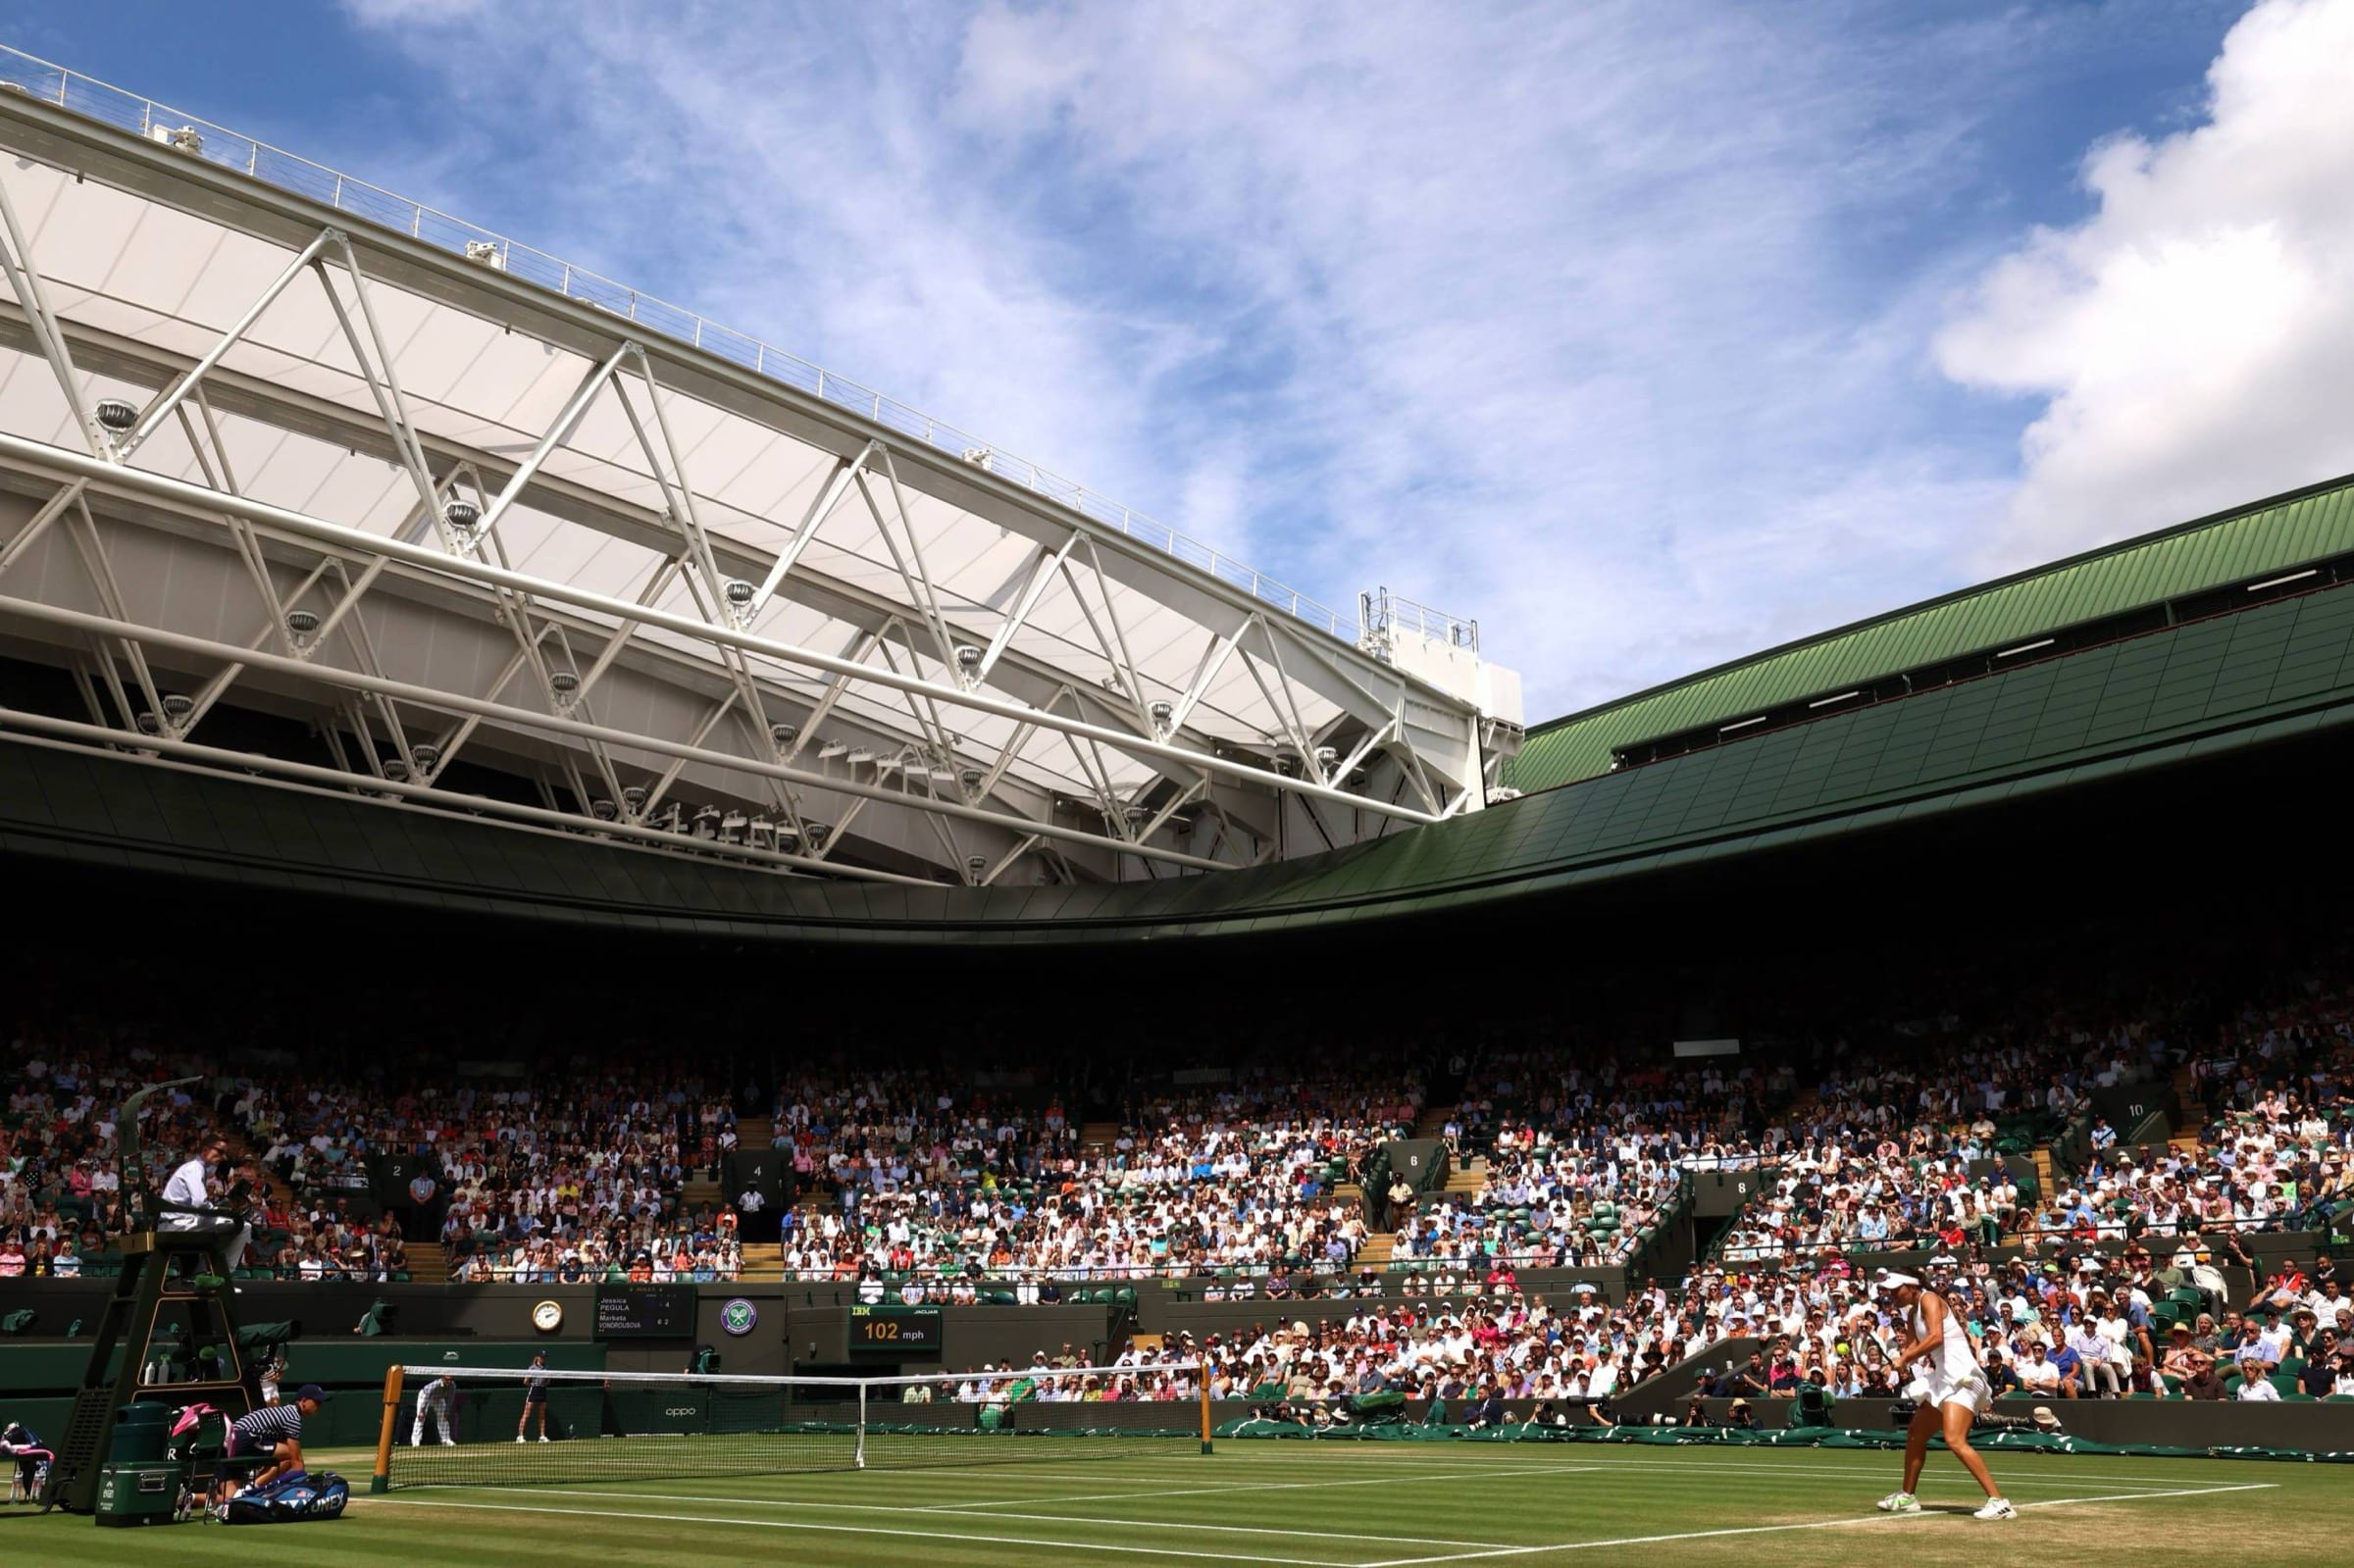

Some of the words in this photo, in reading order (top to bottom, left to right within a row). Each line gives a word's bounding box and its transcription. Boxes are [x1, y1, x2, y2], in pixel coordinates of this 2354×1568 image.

[2128, 1104, 2143, 1117] 10
[1410, 1155, 1418, 1167] 6
[392, 1165, 401, 1177] 2
[753, 1165, 762, 1177] 4
[1738, 1182, 1747, 1193] 8
[852, 1306, 871, 1316] IBM
[864, 1322, 898, 1340] 102
[902, 1330, 924, 1341] mph
[665, 1407, 696, 1418] oppo
[167, 1447, 177, 1460] R
